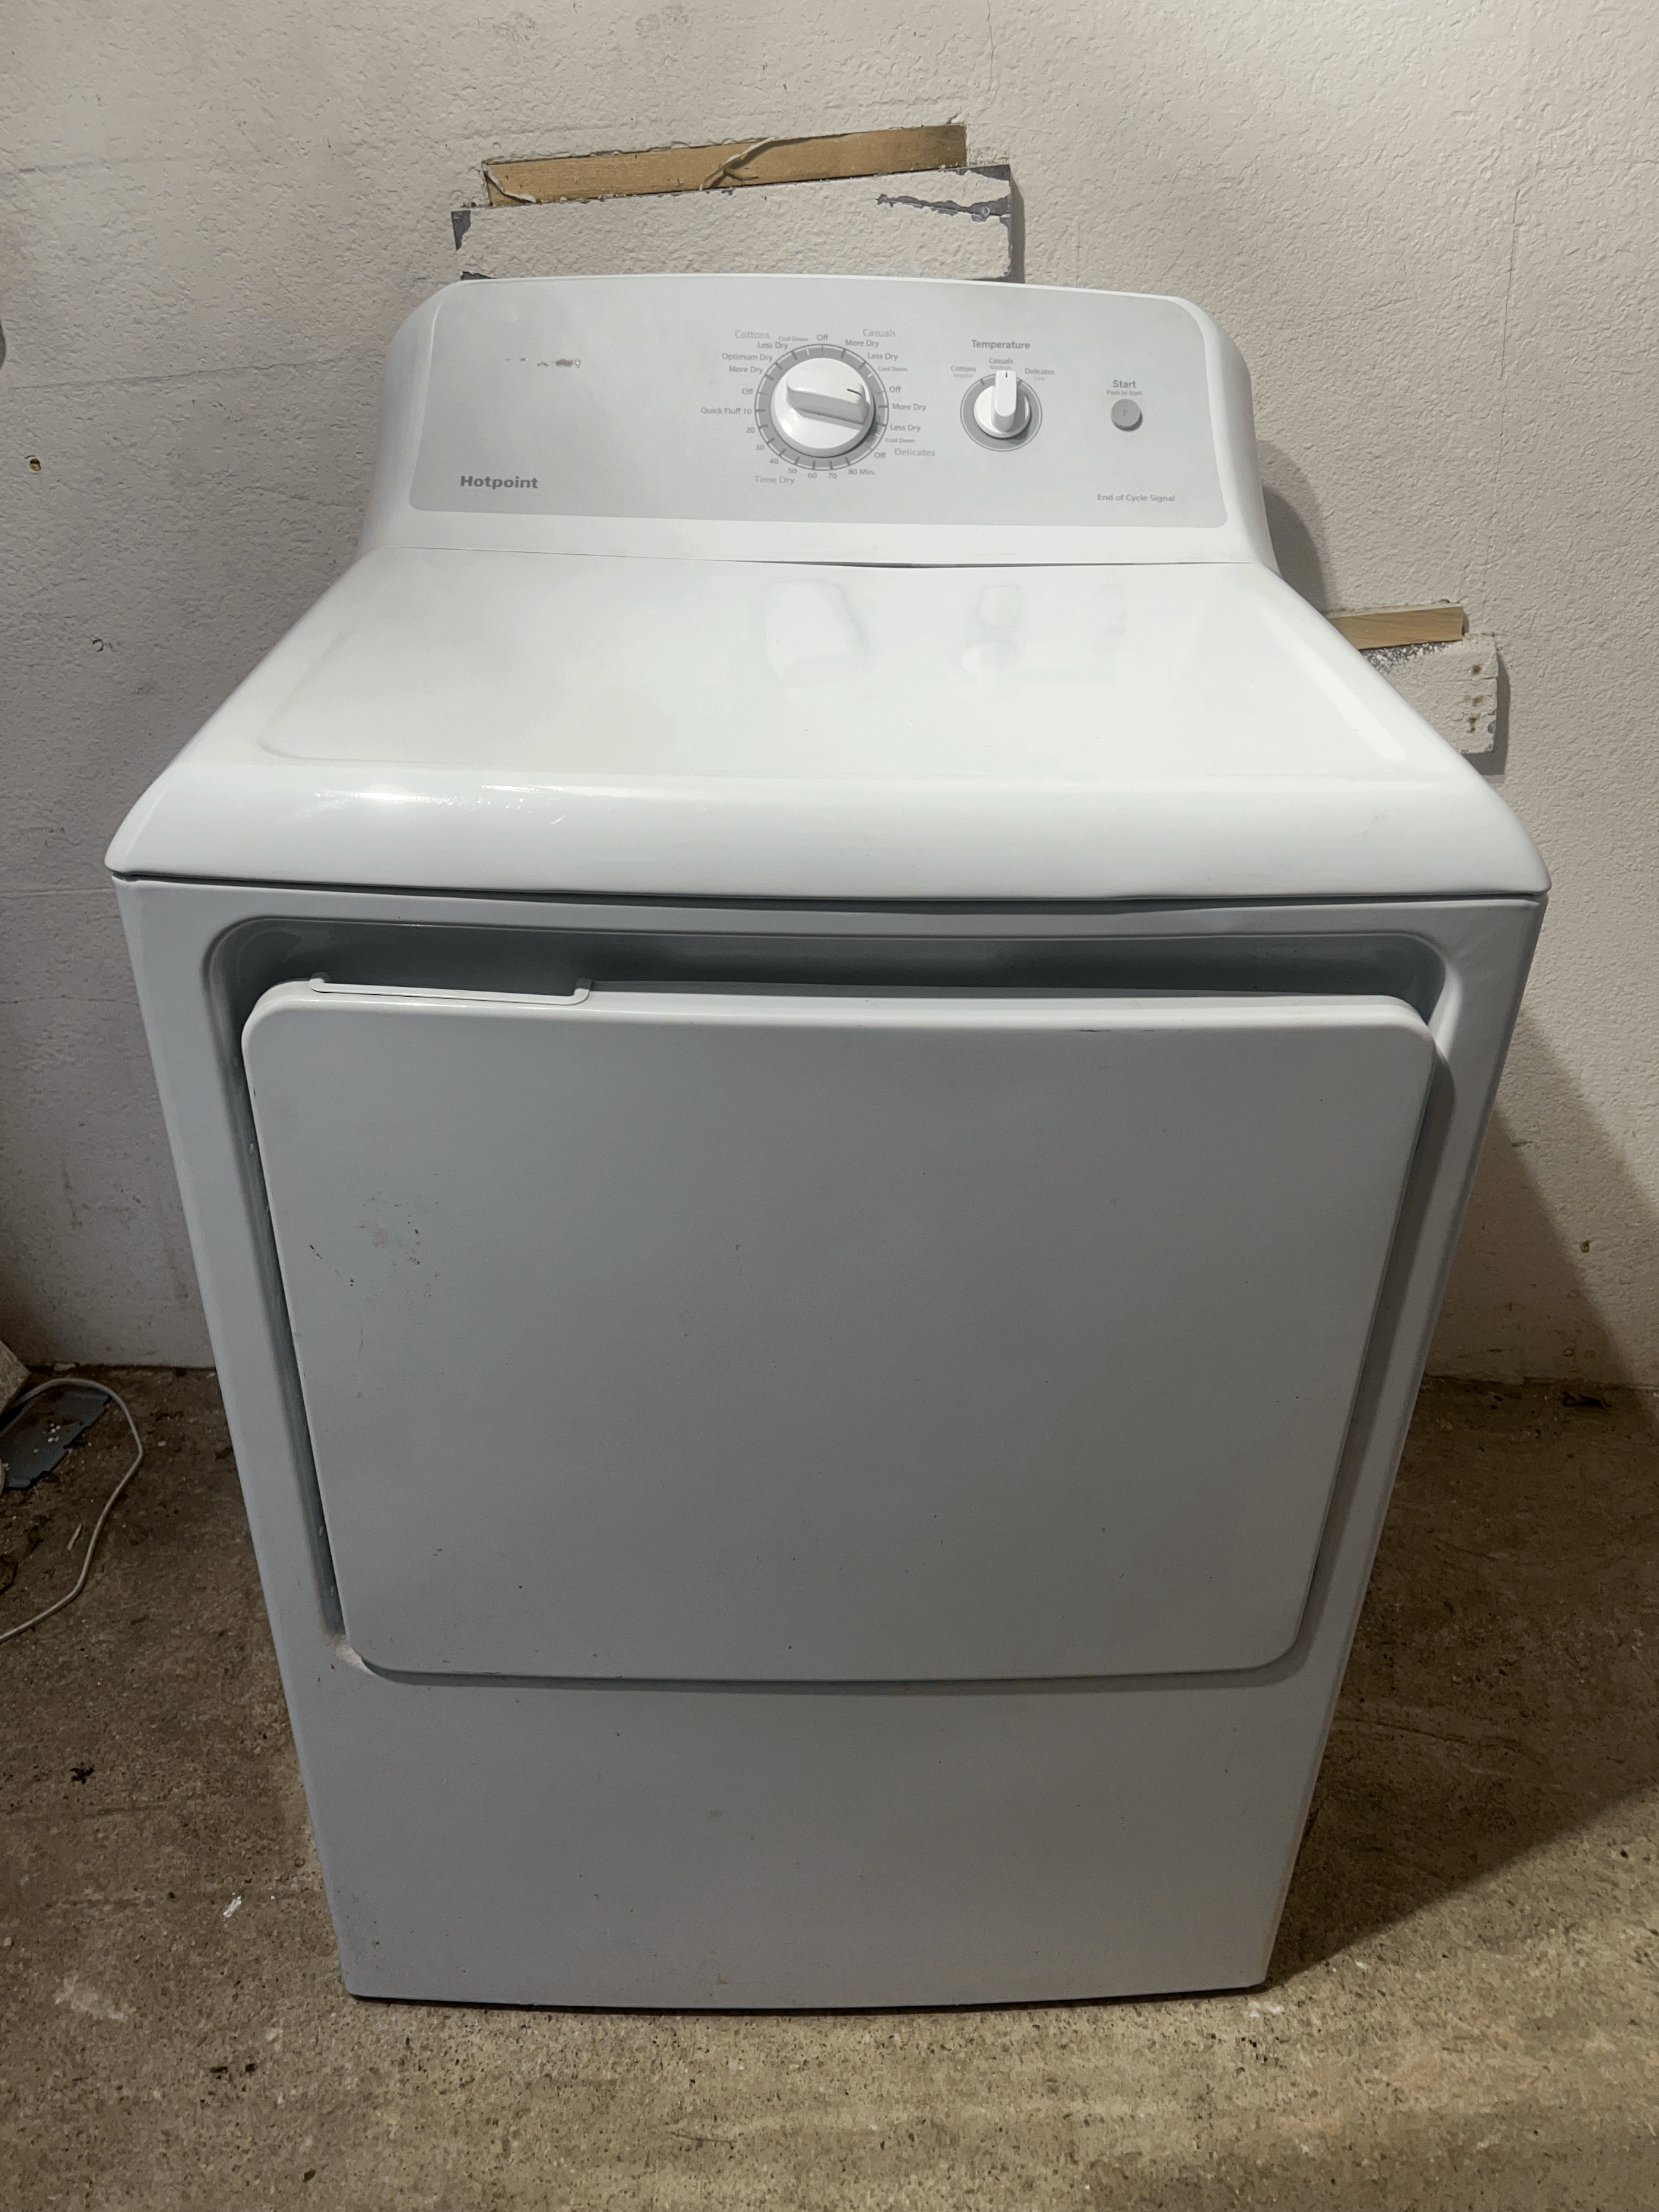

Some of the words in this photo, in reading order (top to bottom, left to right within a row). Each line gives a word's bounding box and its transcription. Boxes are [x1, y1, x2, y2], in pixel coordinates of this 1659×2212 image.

[735, 330, 770, 339] Cottons
[863, 329, 896, 337] Casuals
[775, 342, 788, 350] Dry
[866, 339, 879, 348] Dry
[972, 340, 1030, 350] Temperature
[722, 353, 758, 362] Optimum
[760, 354, 773, 362] Dry
[885, 352, 898, 361] Dry
[1113, 380, 1136, 388] Start
[895, 448, 936, 457] Delicates
[461, 475, 538, 490] Hotpoint
[779, 476, 795, 485] Dry
[1150, 494, 1175, 503] Signal
